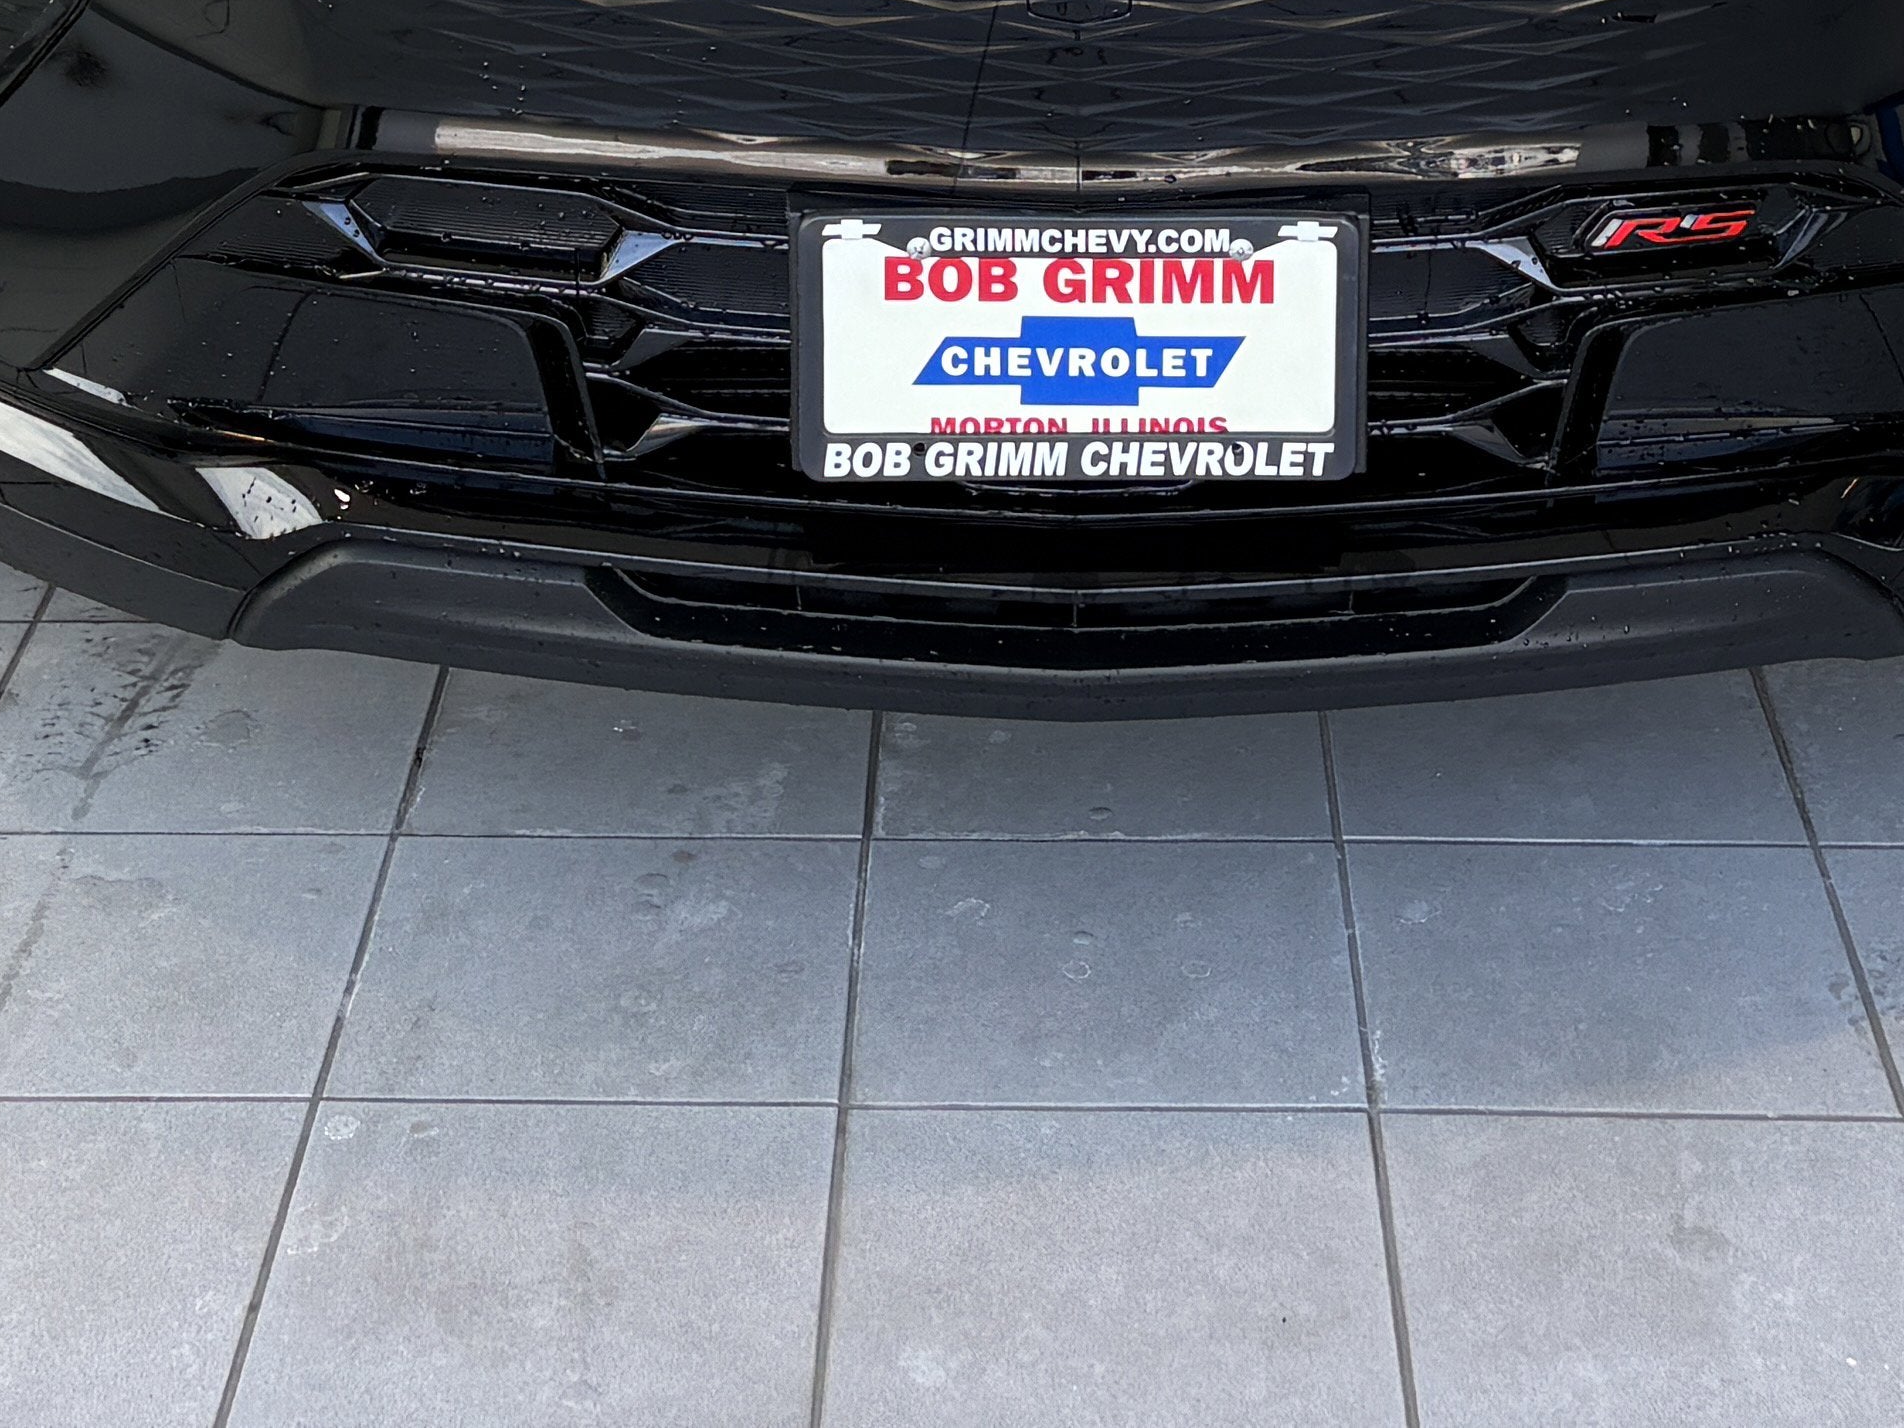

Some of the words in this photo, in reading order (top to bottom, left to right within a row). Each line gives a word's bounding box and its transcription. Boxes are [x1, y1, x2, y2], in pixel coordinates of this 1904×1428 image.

[928, 226, 1230, 255] GRIMMCHEVY.COM
[1591, 210, 1756, 249] RS
[884, 256, 1019, 301] BOB
[1043, 258, 1275, 305] GRIMM
[940, 346, 1214, 378] CHEVROLET
[823, 442, 911, 477] BOB
[924, 441, 1067, 477] GRIMM
[1080, 441, 1335, 477] CHEVROLET
